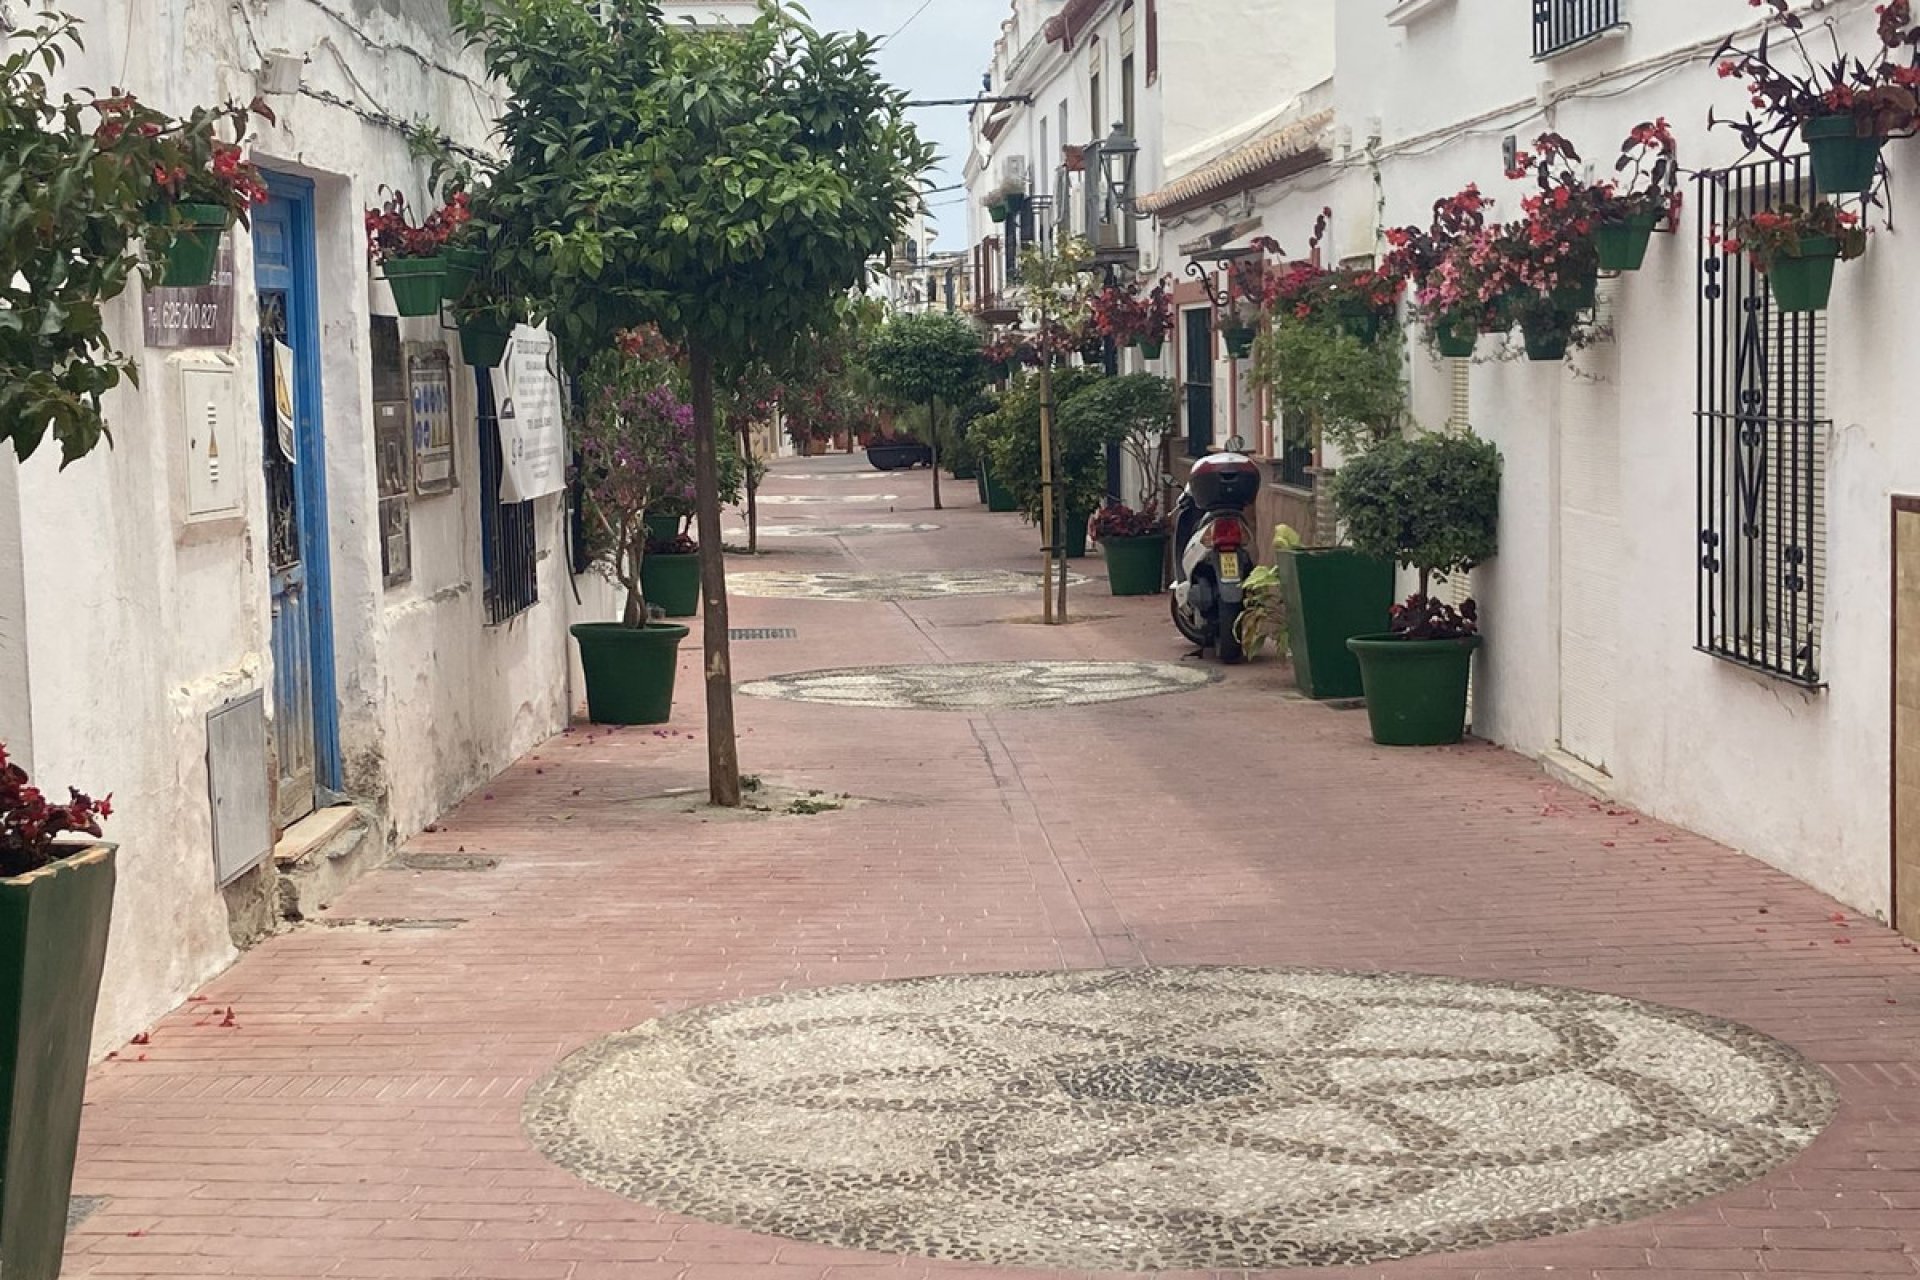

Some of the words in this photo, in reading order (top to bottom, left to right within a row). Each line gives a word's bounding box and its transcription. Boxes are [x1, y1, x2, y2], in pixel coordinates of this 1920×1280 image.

[162, 301, 181, 328] 625
[182, 302, 200, 328] 210
[201, 303, 217, 328] 827
